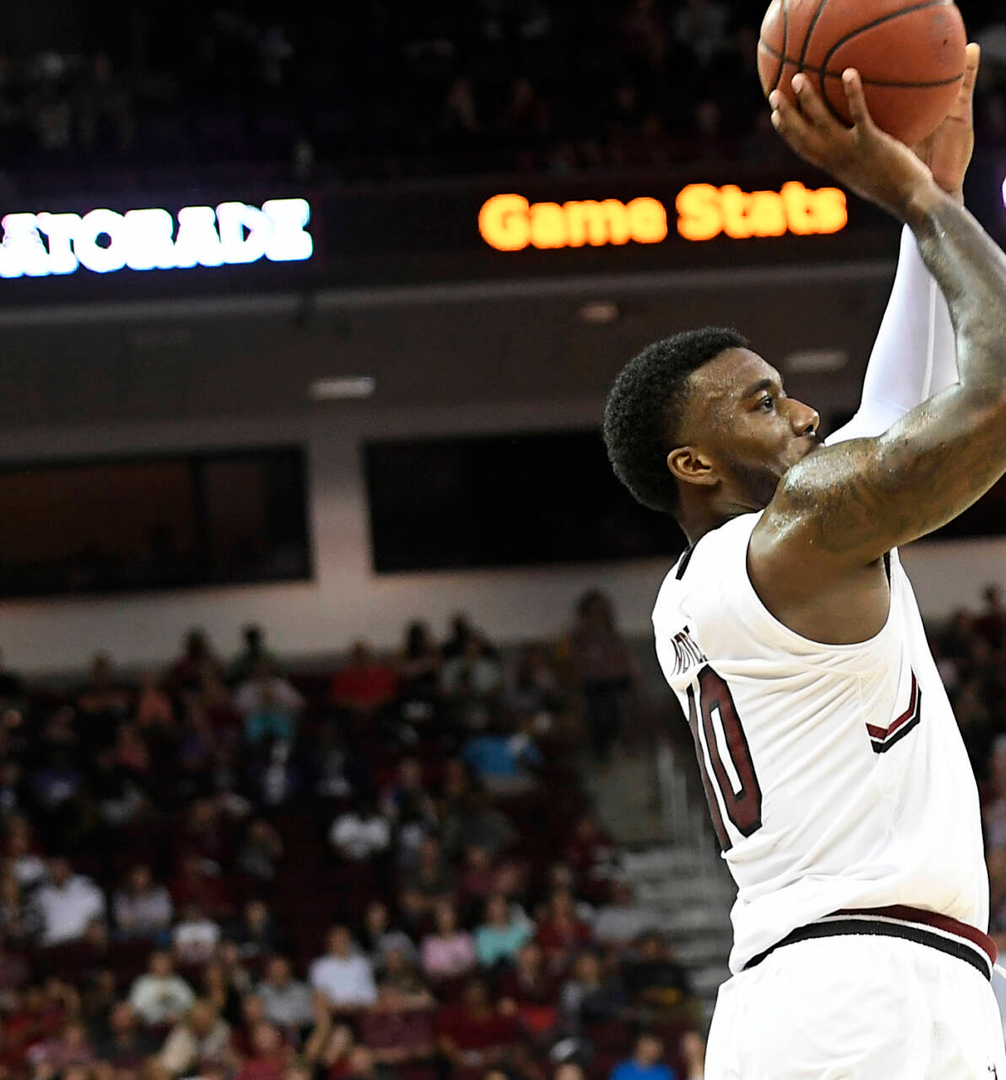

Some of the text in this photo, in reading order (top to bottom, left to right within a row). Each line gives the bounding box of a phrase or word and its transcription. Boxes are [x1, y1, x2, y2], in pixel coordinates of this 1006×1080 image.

[478, 181, 848, 252] Game Stats
[685, 663, 763, 854] 10
